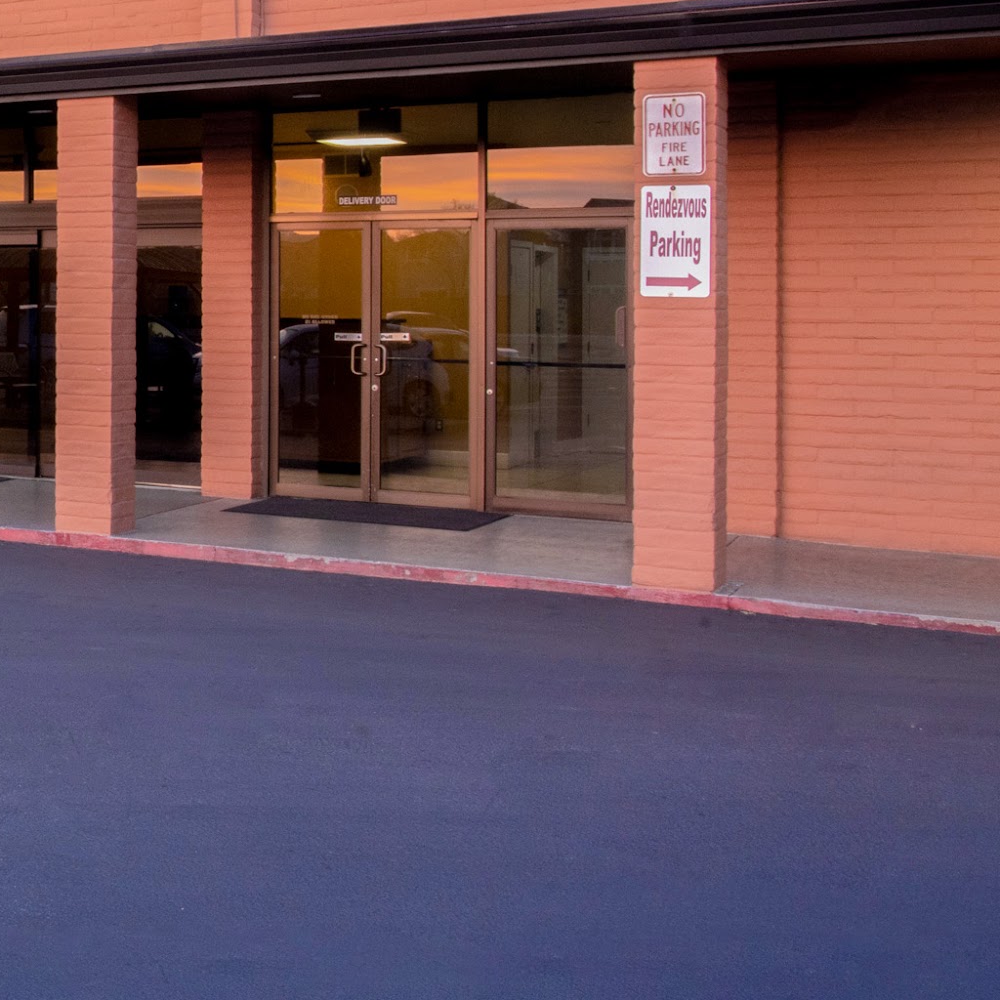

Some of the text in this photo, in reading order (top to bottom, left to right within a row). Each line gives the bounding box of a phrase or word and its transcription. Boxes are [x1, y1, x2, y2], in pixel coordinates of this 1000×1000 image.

[662, 103, 685, 118] NO
[648, 120, 700, 138] PARKING
[661, 141, 687, 153] FIRE
[658, 155, 690, 167] LANE
[338, 195, 397, 206] DELIVERY DOOR
[645, 191, 707, 219] Rendezvous
[649, 230, 702, 265] Parking
